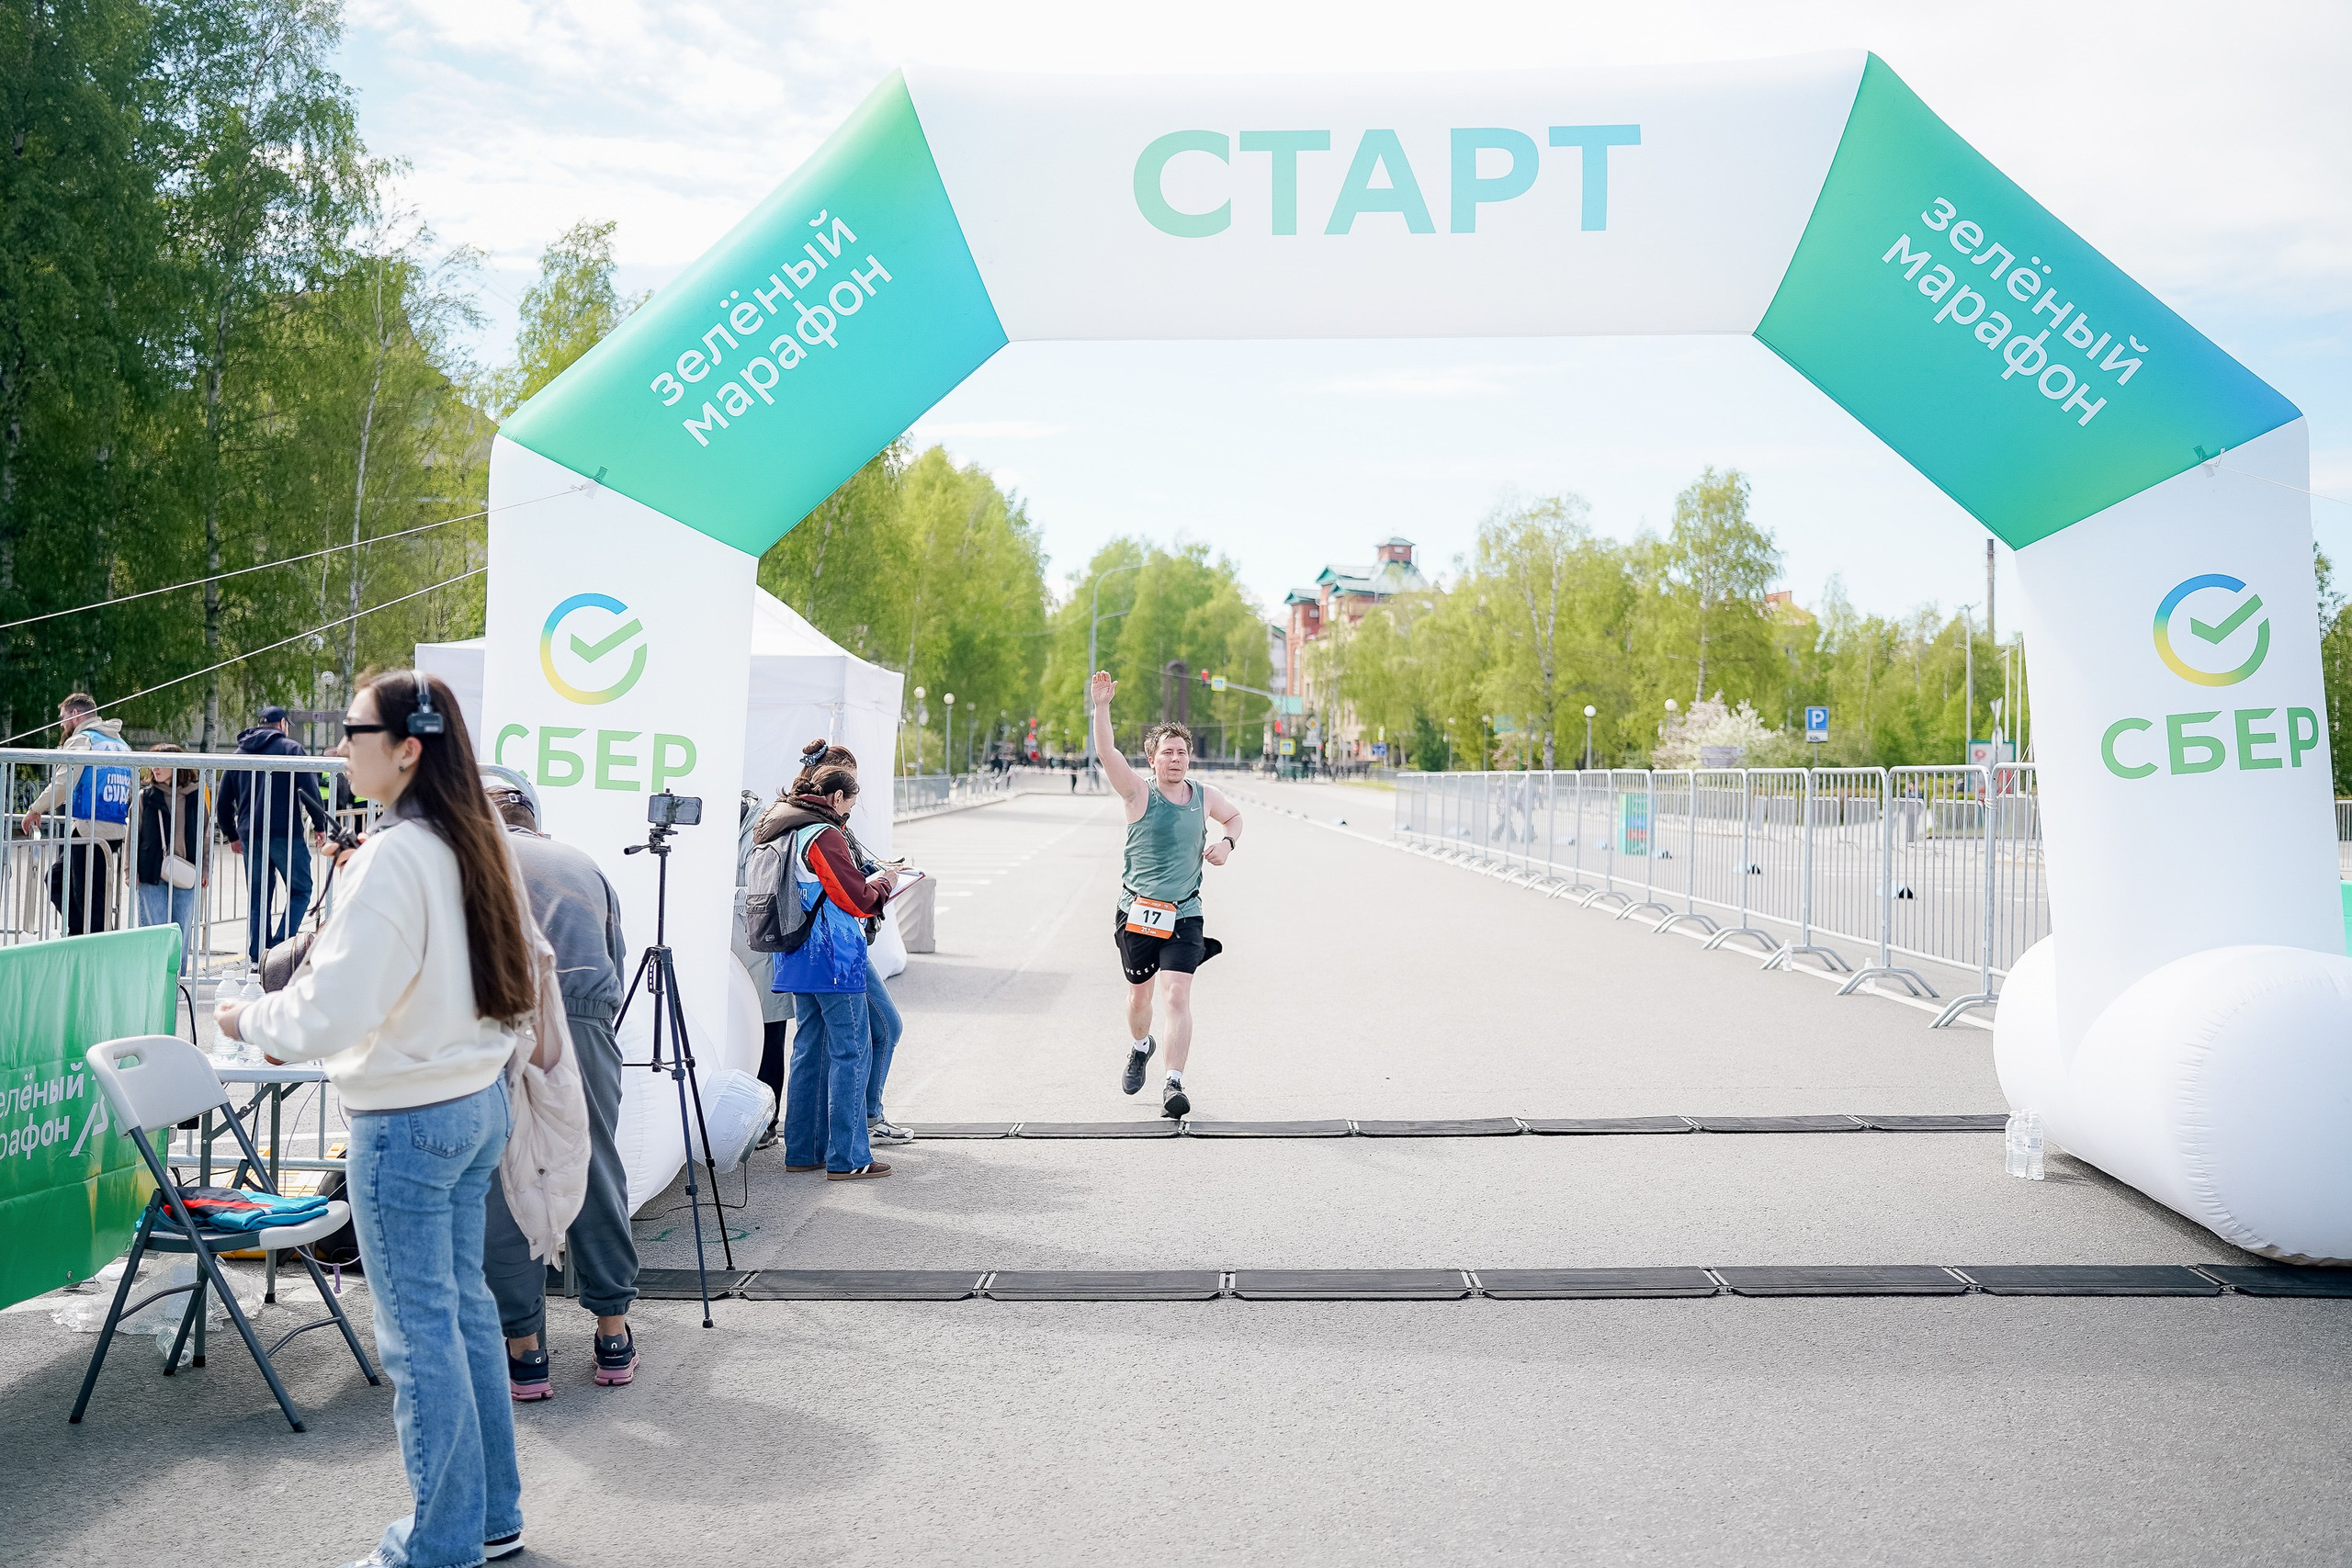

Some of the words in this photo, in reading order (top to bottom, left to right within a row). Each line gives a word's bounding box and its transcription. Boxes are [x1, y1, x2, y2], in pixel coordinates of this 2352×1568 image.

[1133, 123, 1642, 239] СТАРТ
[649, 208, 858, 407] зелёный
[1881, 232, 2108, 427] марафон
[1921, 196, 2150, 387] зелёный
[682, 254, 893, 447] марафон
[494, 723, 697, 793] СБЕР
[1812, 710, 1826, 728] P
[2100, 706, 2320, 780] СБЕР
[1143, 909, 1162, 925] 17
